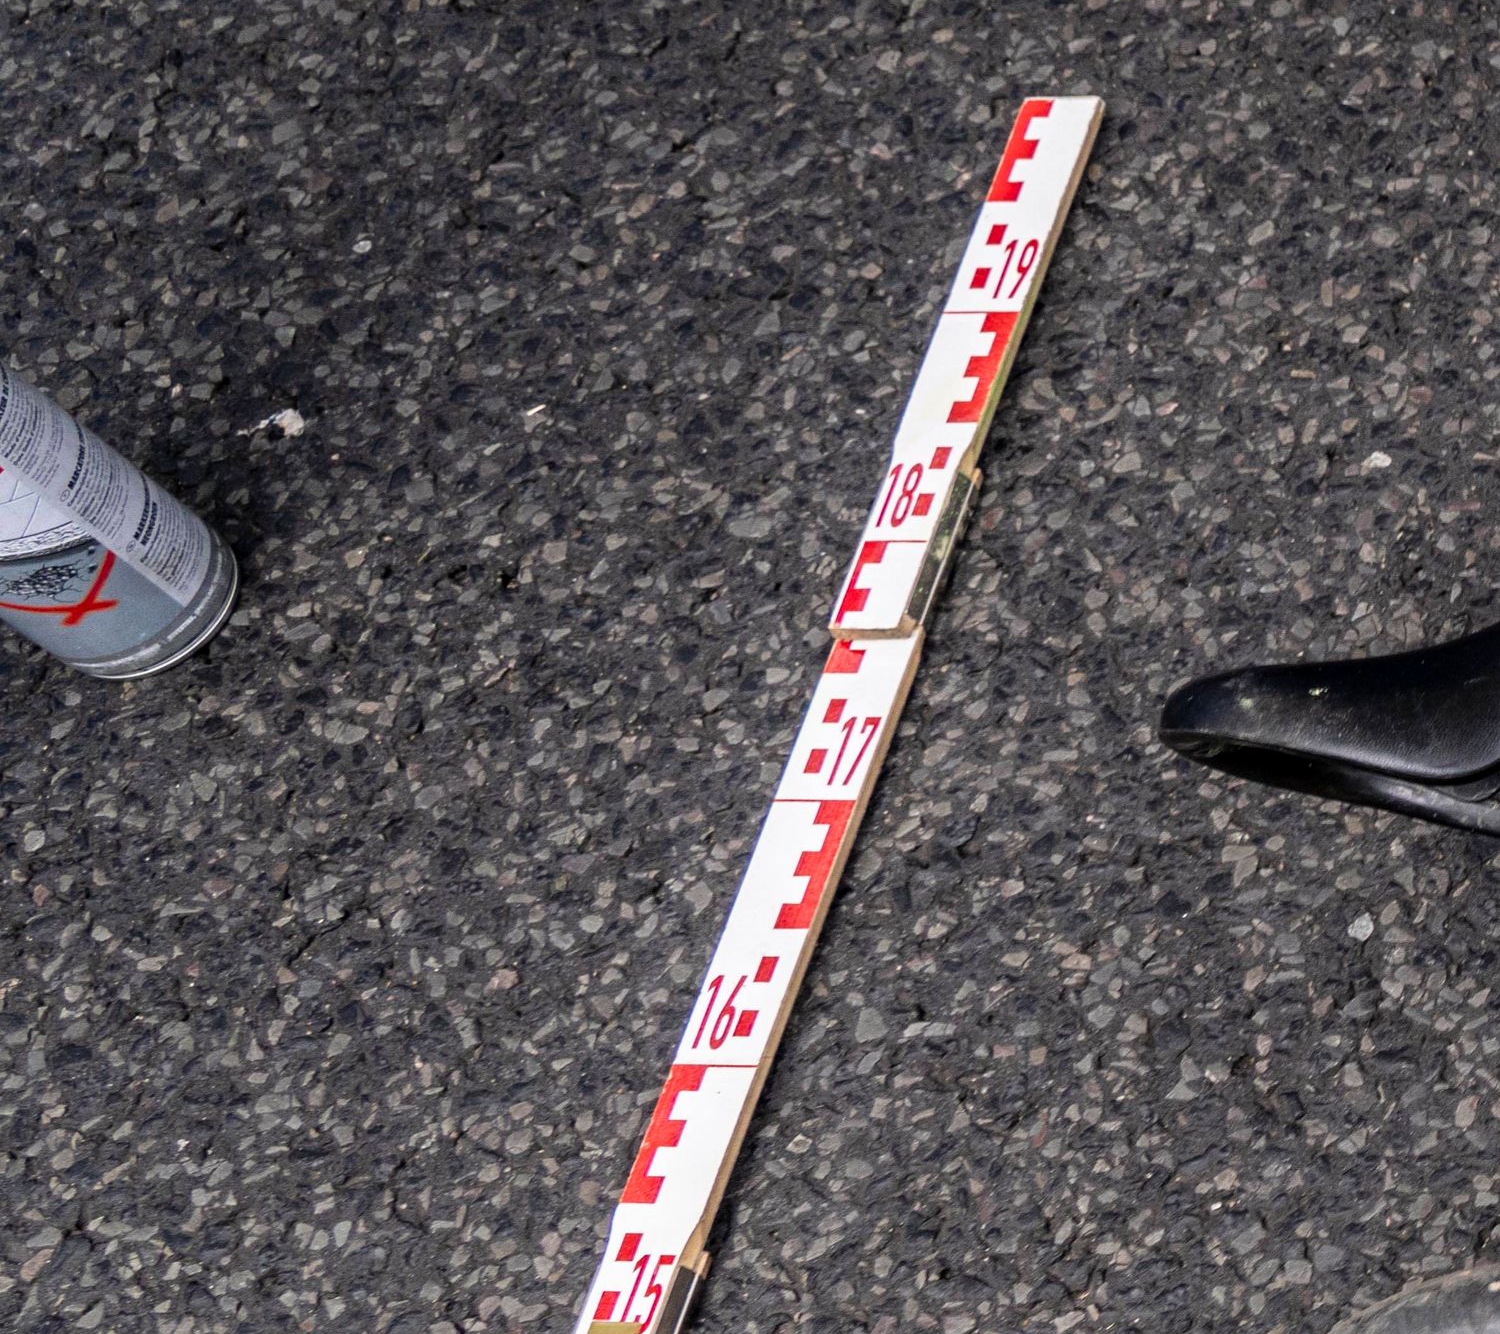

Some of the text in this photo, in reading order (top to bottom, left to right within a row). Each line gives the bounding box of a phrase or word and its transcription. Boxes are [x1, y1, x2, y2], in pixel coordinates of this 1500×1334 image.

[992, 238, 1040, 300] 19
[875, 462, 925, 530] 18
[827, 716, 882, 786] 17
[692, 975, 748, 1050] 16
